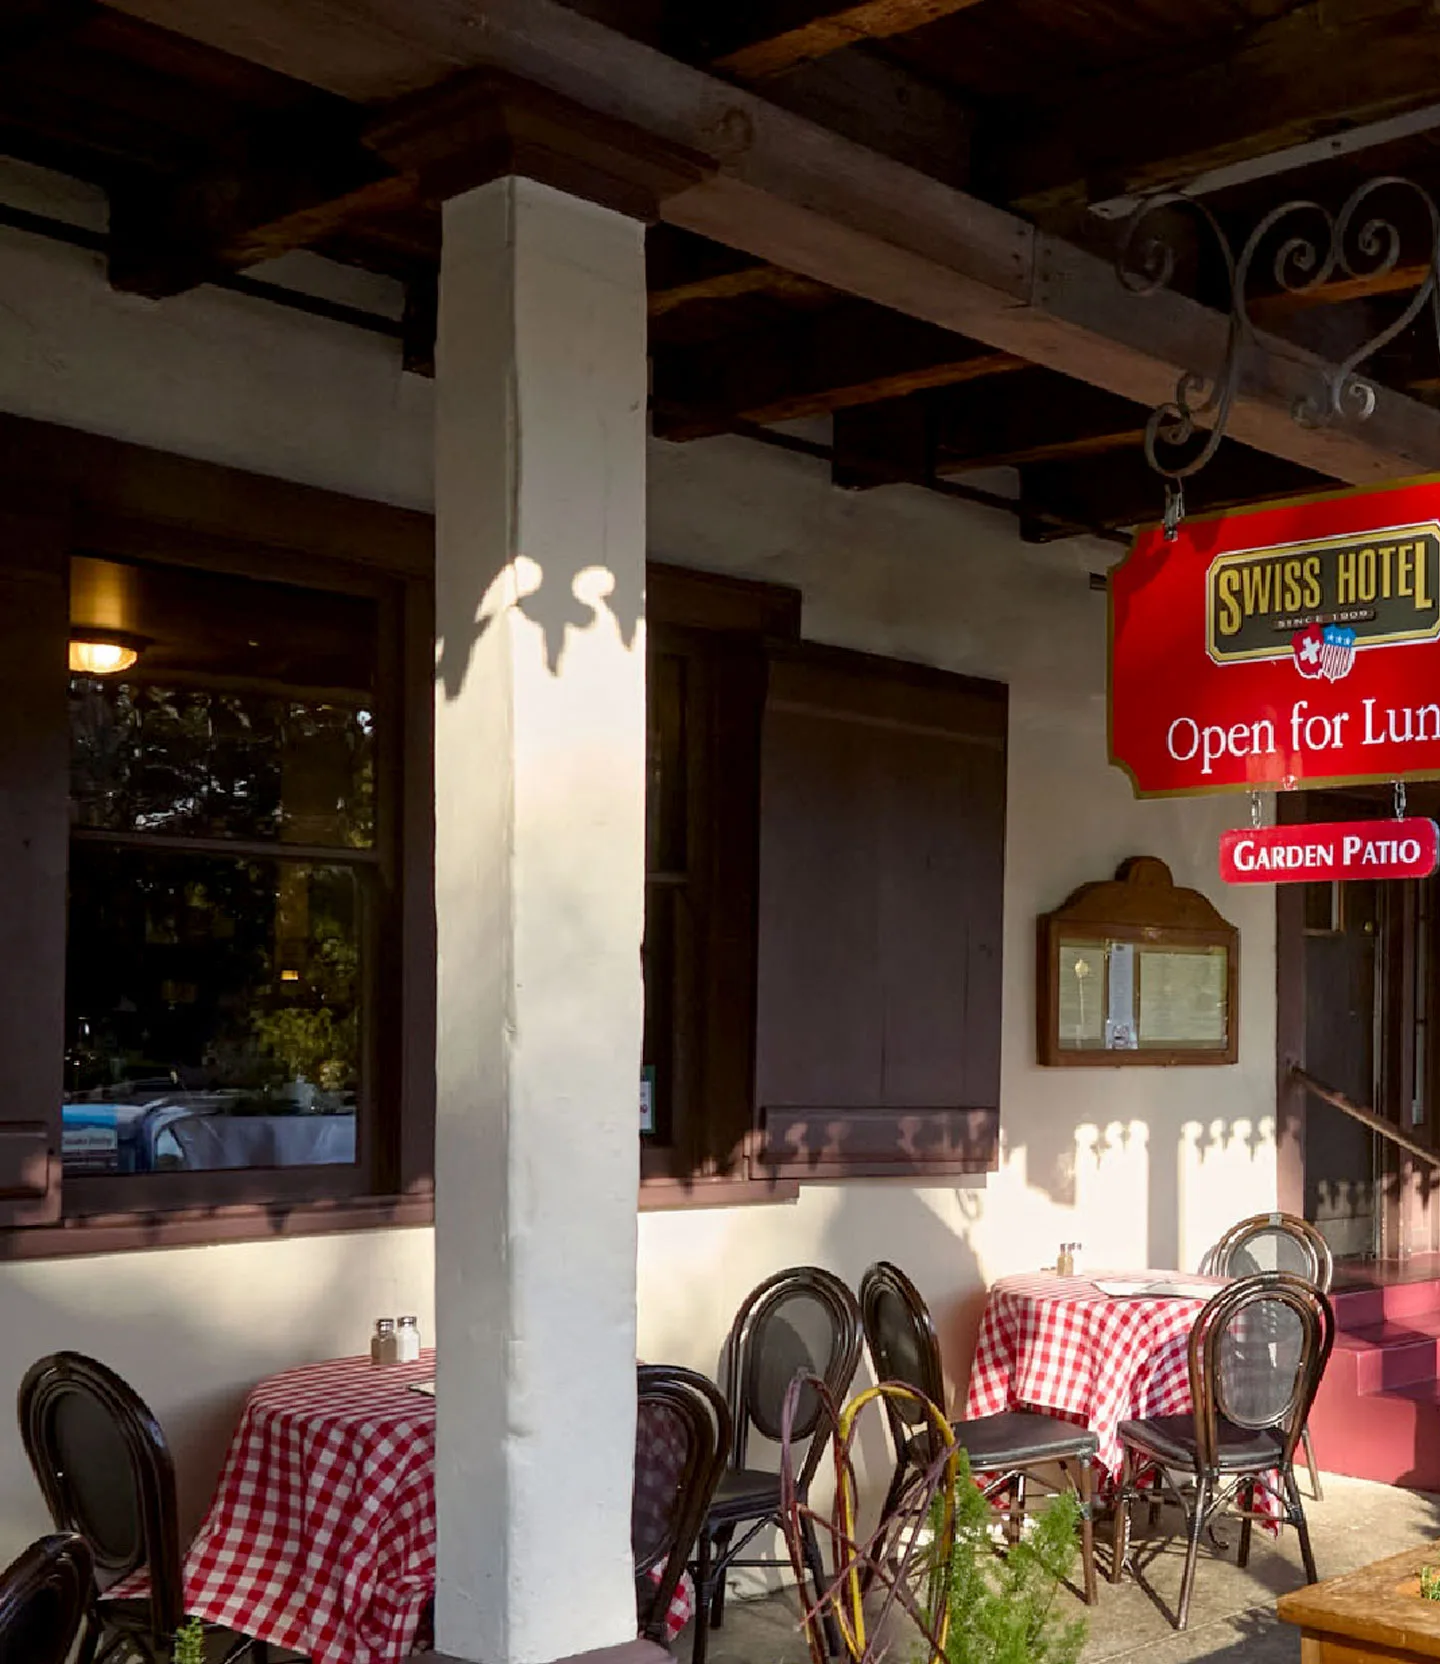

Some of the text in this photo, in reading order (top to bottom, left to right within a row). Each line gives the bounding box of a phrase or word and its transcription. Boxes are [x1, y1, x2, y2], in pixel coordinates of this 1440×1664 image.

[1218, 540, 1433, 636] SWISS HOTEL
[1278, 615, 1323, 629] SINCE
[1166, 717, 1277, 775] Open
[1290, 701, 1349, 751] for
[1233, 836, 1421, 871] GARDEN PATIO
